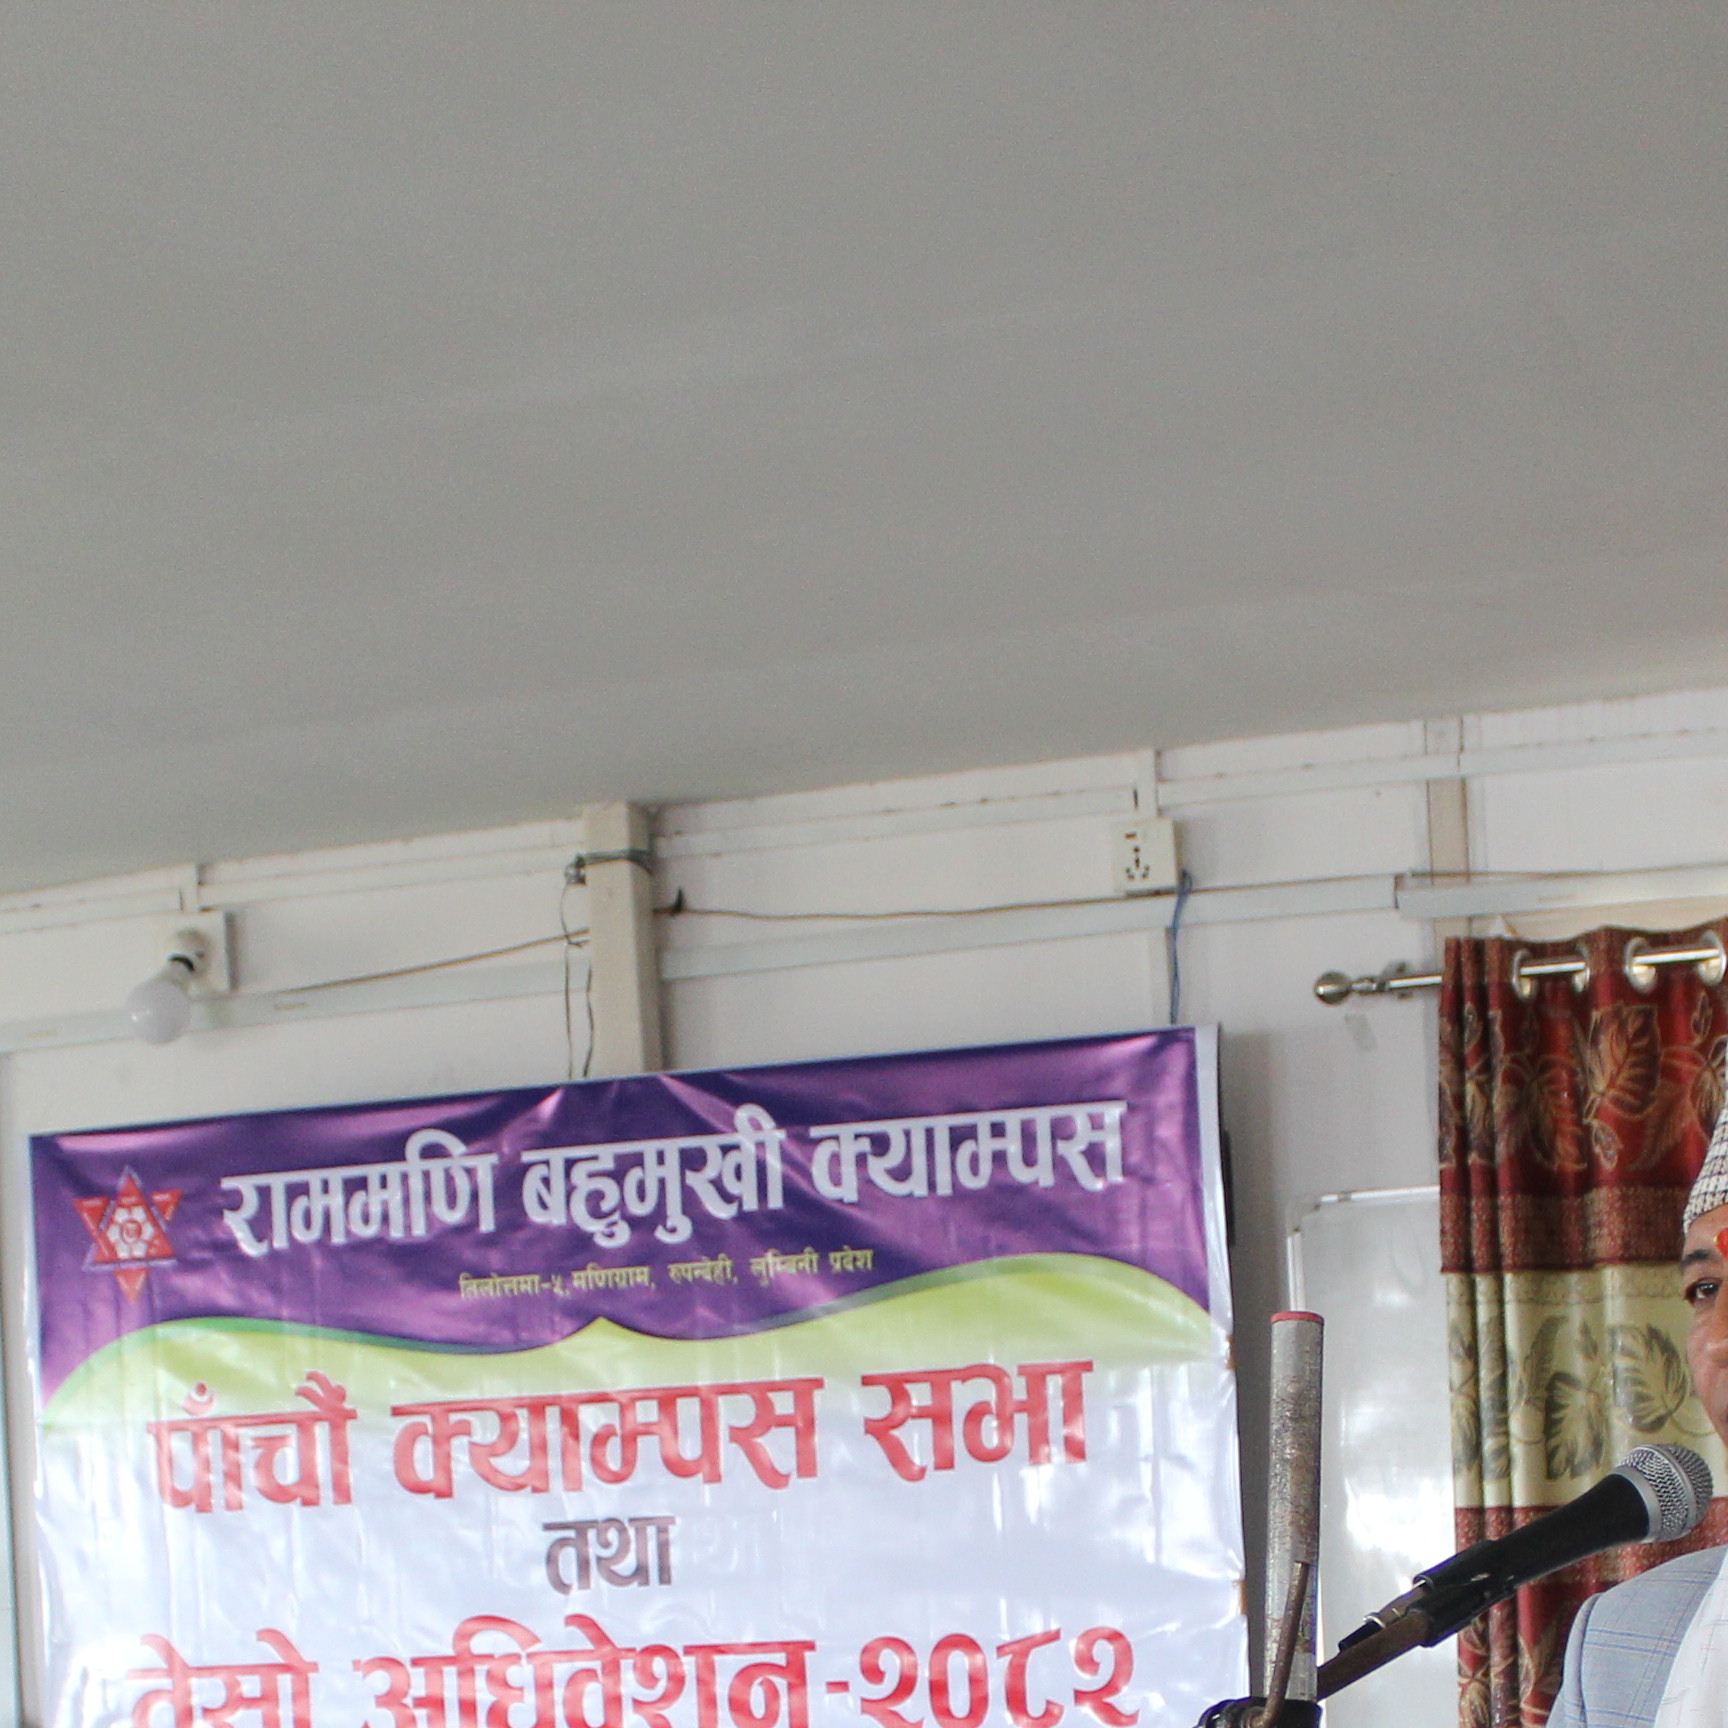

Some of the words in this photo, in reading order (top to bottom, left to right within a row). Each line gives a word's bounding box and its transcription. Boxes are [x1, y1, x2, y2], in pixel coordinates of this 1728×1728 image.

[218, 1128, 499, 1258] राममणि
[521, 1104, 788, 1246] बहुमुखी
[811, 1101, 1128, 1205] क्याम्पस
[391, 1377, 825, 1500] क्याम्पस
[860, 1359, 1093, 1483] सभा
[542, 1515, 673, 1595] तथा
